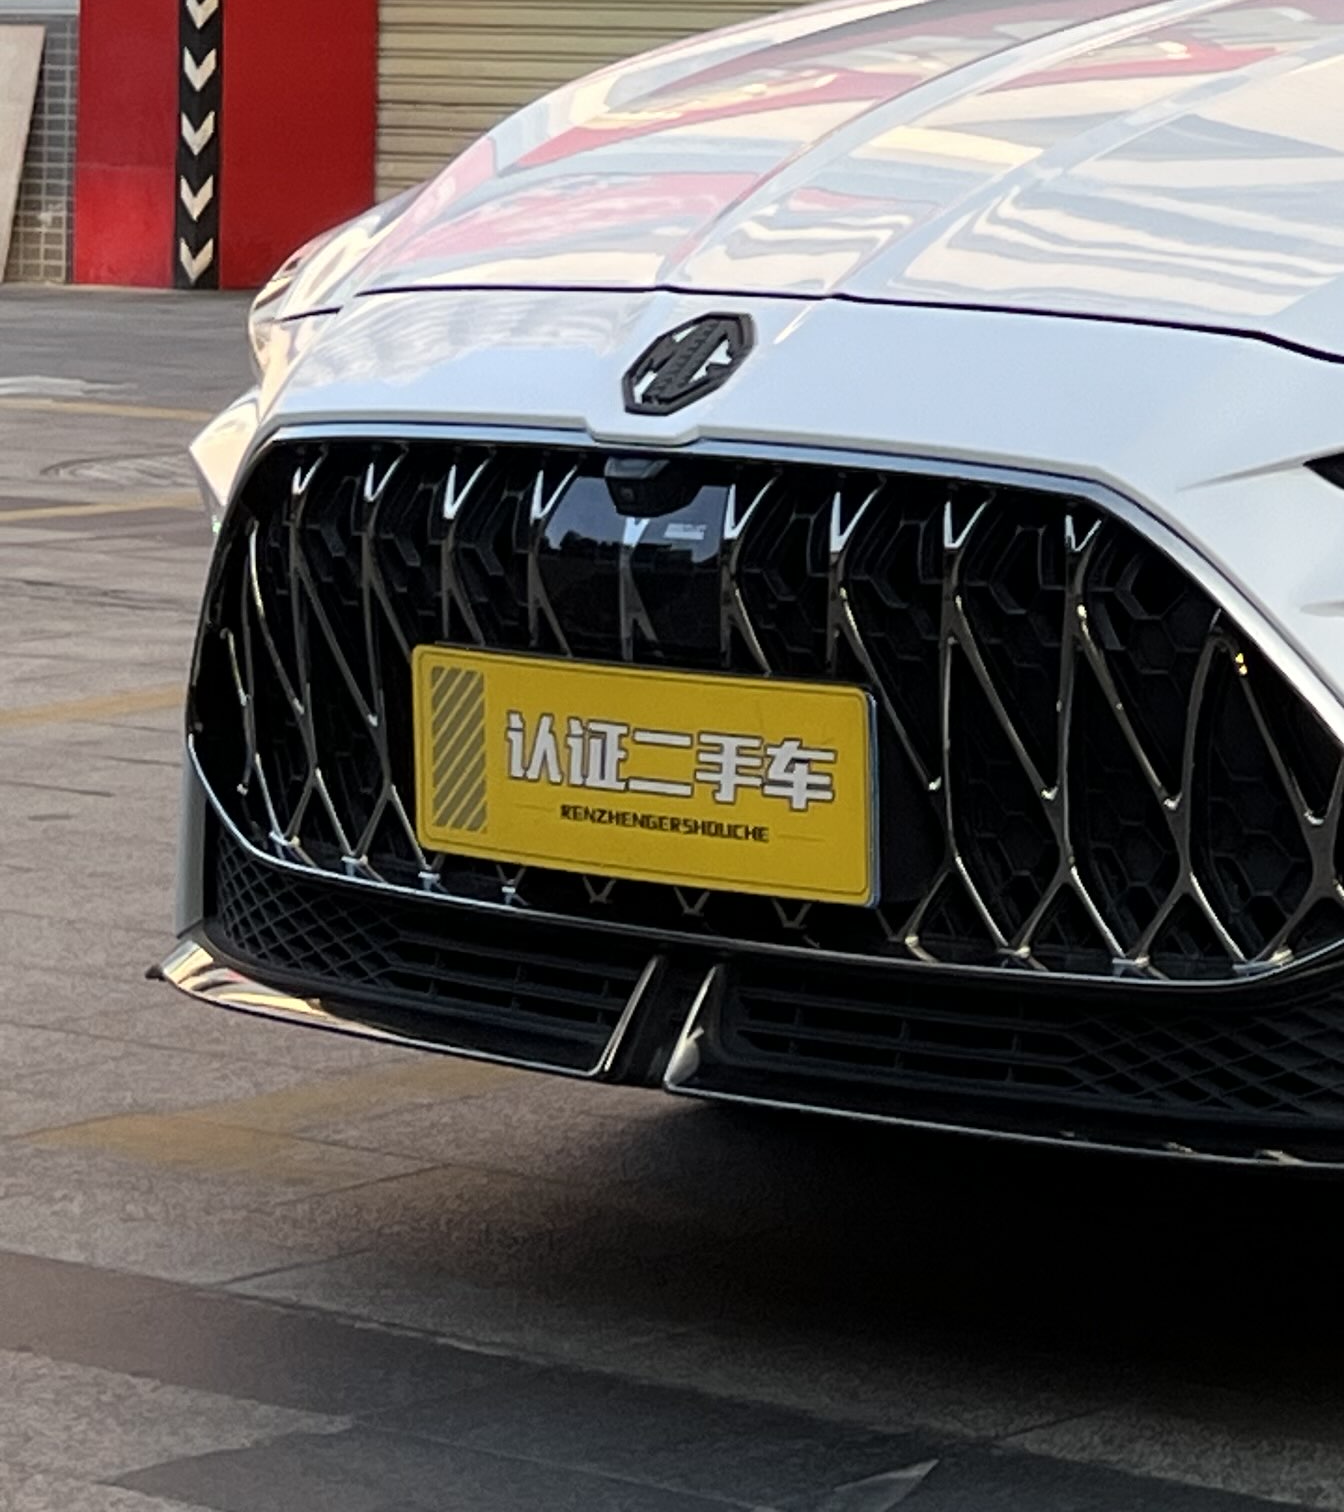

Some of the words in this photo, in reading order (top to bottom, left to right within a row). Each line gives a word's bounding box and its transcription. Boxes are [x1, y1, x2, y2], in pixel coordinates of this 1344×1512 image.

[506, 709, 837, 812] 认证二手车
[560, 804, 769, 843] RENZHENGERSHOUCHE
